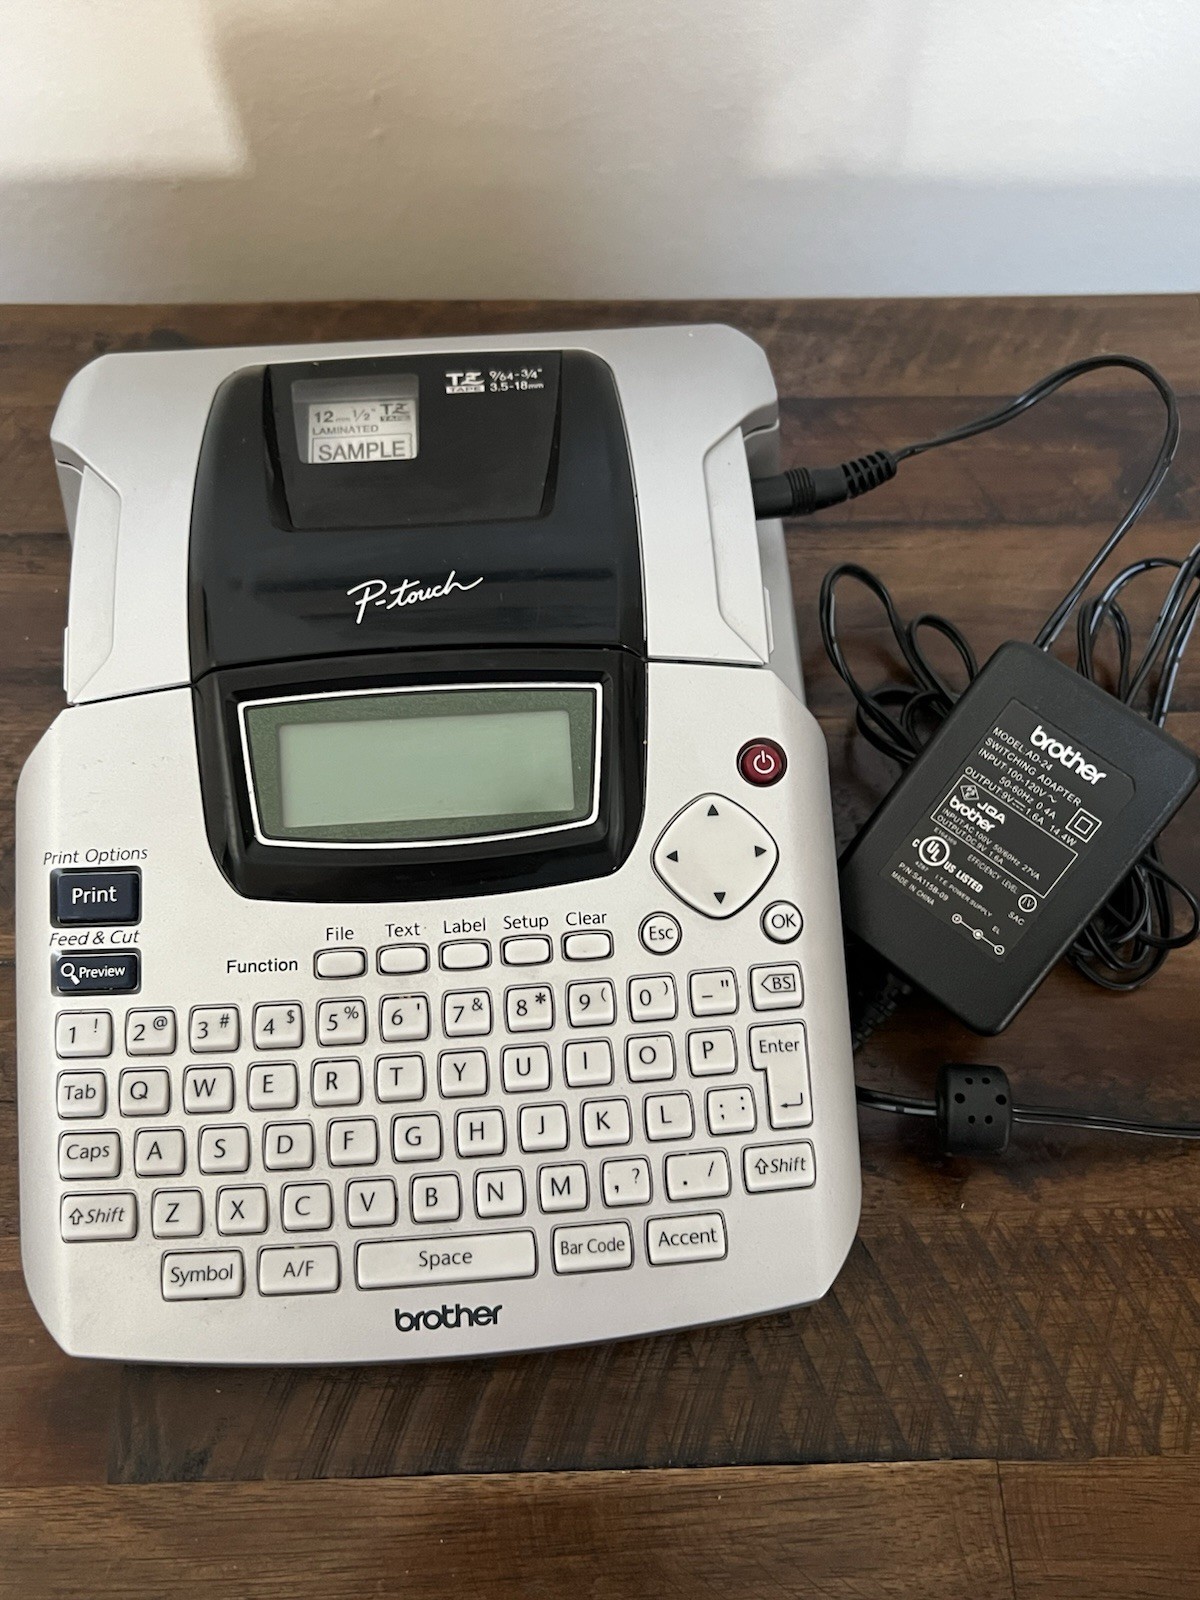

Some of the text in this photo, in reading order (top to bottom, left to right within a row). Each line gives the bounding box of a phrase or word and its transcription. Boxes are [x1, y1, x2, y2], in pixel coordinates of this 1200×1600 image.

[312, 424, 379, 436] LAMINATED
[318, 440, 406, 461] SAMPLE
[346, 570, 484, 625] P-touch
[1030, 724, 1106, 784] brother
[985, 737, 1081, 806] SWITCHING ADAPTER
[998, 776, 1033, 804] 50-60Hz
[949, 794, 995, 832] brother
[976, 802, 1005, 824] JQA
[1025, 807, 1044, 825] 1.6A
[1049, 824, 1076, 846] 14.4W
[44, 848, 148, 865] Print Options
[974, 830, 992, 845] 100V
[992, 843, 1020, 866] 50/60Hz
[1021, 864, 1039, 880] 27VA
[943, 860, 956, 873] US
[955, 869, 983, 892] LISTED
[967, 854, 1001, 879] EFFICIENCY
[1001, 878, 1017, 893] LEVEL
[72, 886, 117, 904] Print
[891, 870, 934, 905] MADE IN CHINA
[444, 918, 486, 934] Label
[503, 915, 549, 930] Setup
[566, 912, 607, 926] Clear
[771, 913, 796, 929] OK
[1007, 911, 1024, 925] SAC
[49, 929, 140, 947] Feed & Cut
[326, 927, 354, 941] File
[385, 923, 420, 937] Text
[649, 926, 673, 940] Esc
[79, 965, 125, 978] Preview
[227, 958, 298, 974] Function
[772, 976, 792, 991] BS
[579, 994, 590, 1011] 9
[639, 989, 652, 1006] 0
[453, 998, 483, 1023] 7 &
[516, 999, 528, 1016] 8
[197, 1014, 230, 1039] 3 #
[263, 1009, 295, 1035] 4 $
[327, 1006, 359, 1031] 5 %
[391, 1009, 403, 1026] 6
[69, 1027, 76, 1044] 1
[133, 1016, 168, 1041] 2 @
[639, 1046, 656, 1064] O
[702, 1041, 714, 1059] P
[759, 1039, 799, 1053] Enter
[516, 1057, 531, 1076] U
[583, 1051, 587, 1070] I
[326, 1071, 338, 1090] R
[389, 1067, 403, 1086] T
[453, 1062, 466, 1081] Y
[64, 1084, 96, 1100] Tab
[130, 1081, 148, 1100] Q
[193, 1078, 216, 1097] W
[263, 1074, 273, 1093] E
[596, 1111, 610, 1130] K
[660, 1105, 672, 1124] L
[470, 1121, 484, 1141] H
[538, 1115, 544, 1135] J
[277, 1135, 293, 1154] D
[344, 1131, 354, 1150] F
[405, 1126, 421, 1146] G
[66, 1144, 109, 1162] Caps
[147, 1141, 162, 1160] A
[214, 1139, 226, 1158] S
[708, 1161, 714, 1177] /
[770, 1157, 805, 1173] Shift
[632, 1168, 640, 1183] ?
[487, 1181, 503, 1202] N
[551, 1176, 570, 1196] M
[295, 1196, 310, 1216] C
[360, 1192, 375, 1212] V
[426, 1187, 438, 1207] B
[85, 1207, 125, 1224] Shift
[165, 1203, 179, 1223] Z
[230, 1200, 245, 1220] X
[561, 1237, 625, 1255] Bar Code
[658, 1228, 717, 1247] Accent
[283, 1260, 314, 1277] A/F
[419, 1251, 472, 1270] Space
[170, 1263, 233, 1287] Symbol
[394, 1304, 503, 1332] brother
